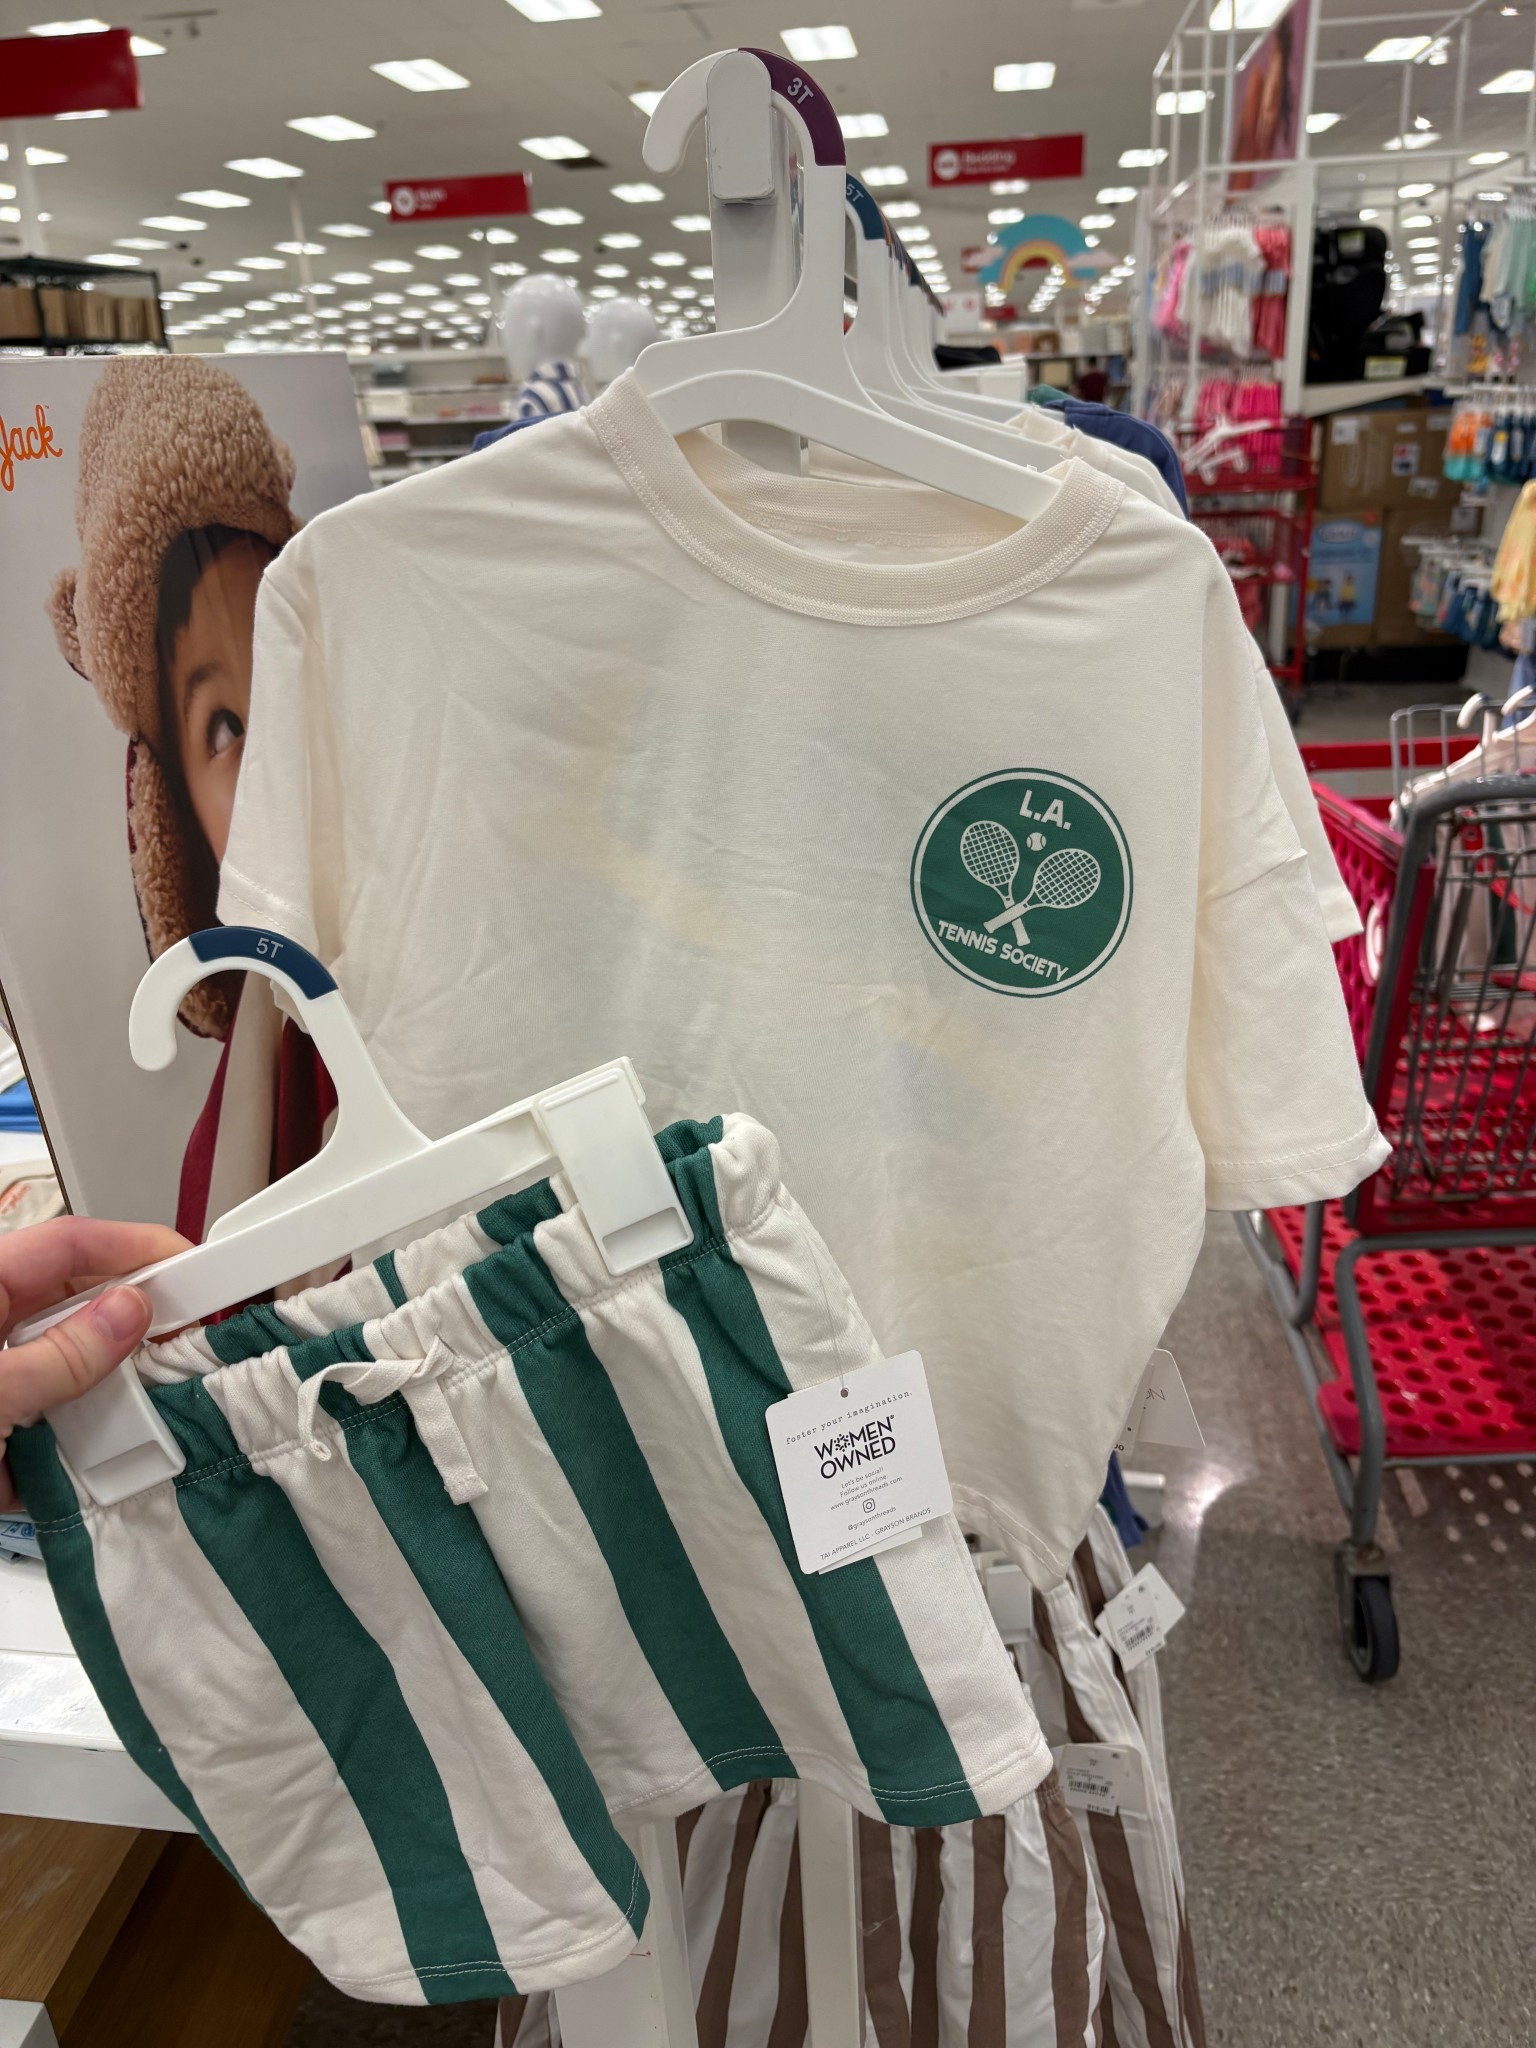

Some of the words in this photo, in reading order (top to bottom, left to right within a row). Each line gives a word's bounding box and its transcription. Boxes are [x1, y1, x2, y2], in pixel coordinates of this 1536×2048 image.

[787, 77, 814, 105] 3T
[846, 184, 864, 203] 5T
[0, 404, 63, 492] Jack
[1019, 789, 1072, 830] L.A.
[256, 937, 284, 959] 5T
[938, 920, 999, 955] TENNIS
[999, 943, 1069, 982] SOCIETY
[785, 1426, 817, 1445] foster
[820, 1415, 843, 1431] your
[846, 1391, 913, 1419] imagination.
[820, 1436, 896, 1479] OWNED
[830, 1476, 903, 1511] www.graysonthreads.com
[839, 1485, 860, 1498] Follow
[841, 1478, 855, 1489] Let's
[855, 1475, 864, 1483] be
[831, 1539, 859, 1556] APPAREL
[858, 1533, 871, 1543] LLC
[874, 1517, 905, 1536] GRAYSON
[905, 1507, 932, 1522] BRANDS
[847, 1506, 897, 1531] @graysonthreads
